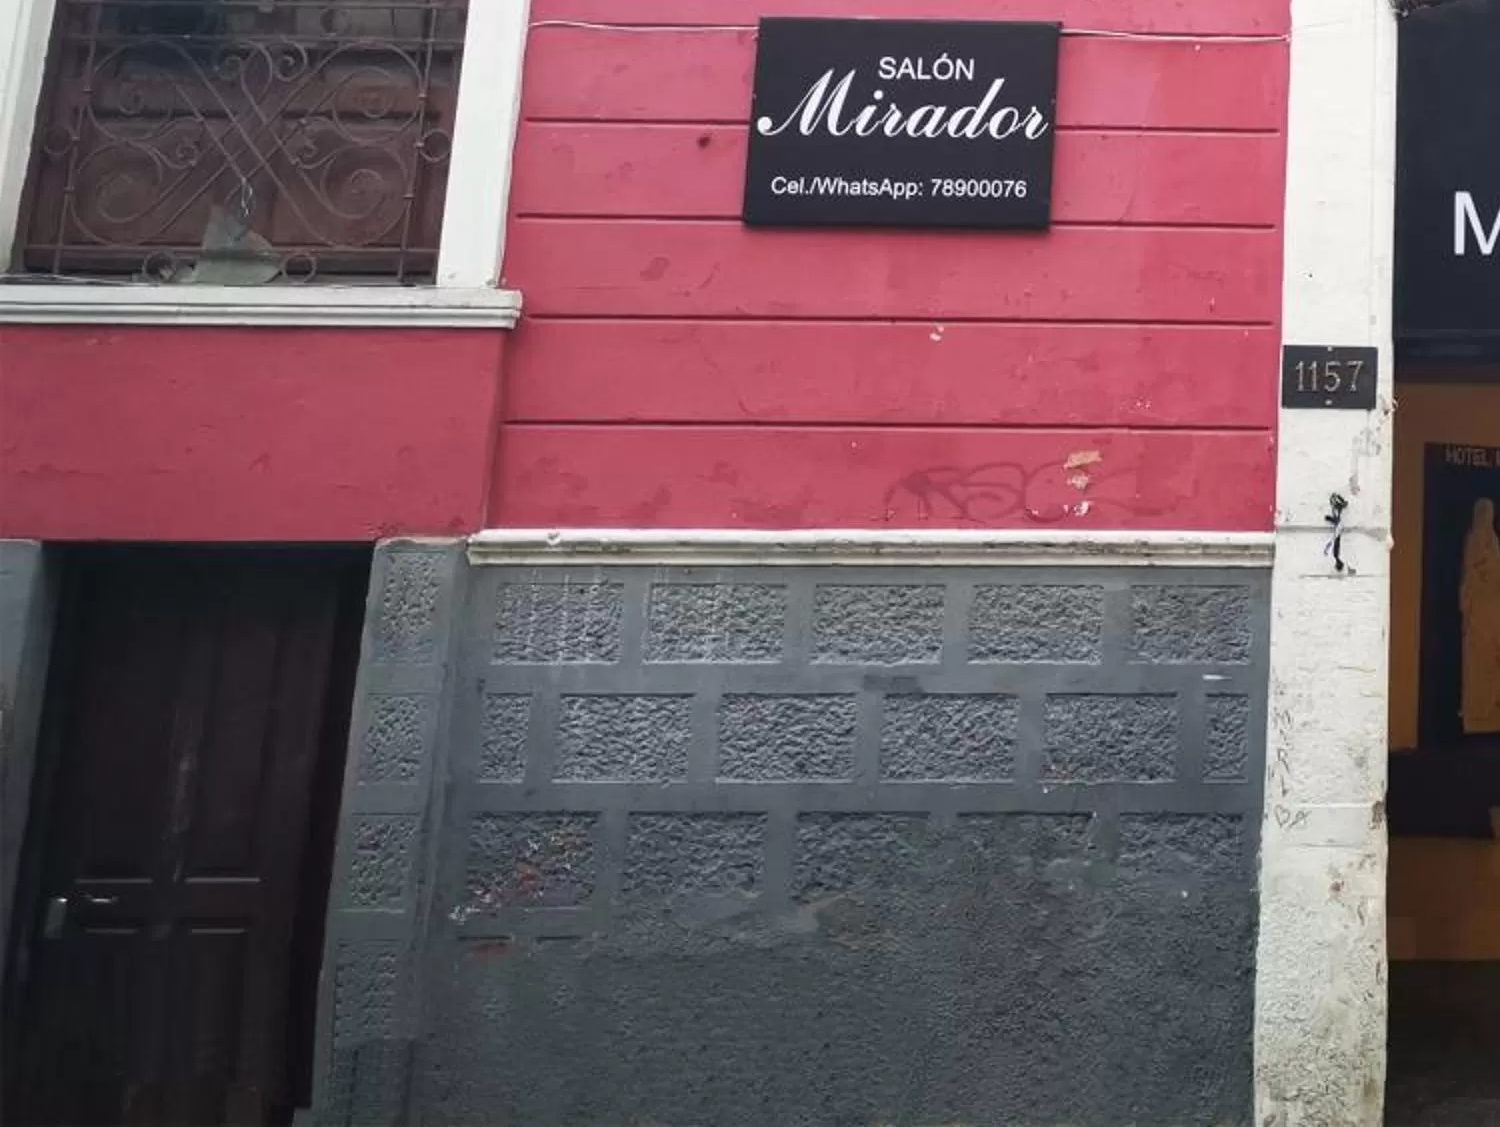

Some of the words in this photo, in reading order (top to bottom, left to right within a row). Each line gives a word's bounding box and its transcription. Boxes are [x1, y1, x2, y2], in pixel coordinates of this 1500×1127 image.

[877, 53, 975, 81] SALÓN
[756, 68, 1049, 140] Mirador
[770, 176, 924, 200] Cel./WhatsApp:
[931, 178, 1028, 198] 78900076
[1295, 360, 1364, 392] 1157
[1444, 445, 1491, 468] HOTEL
